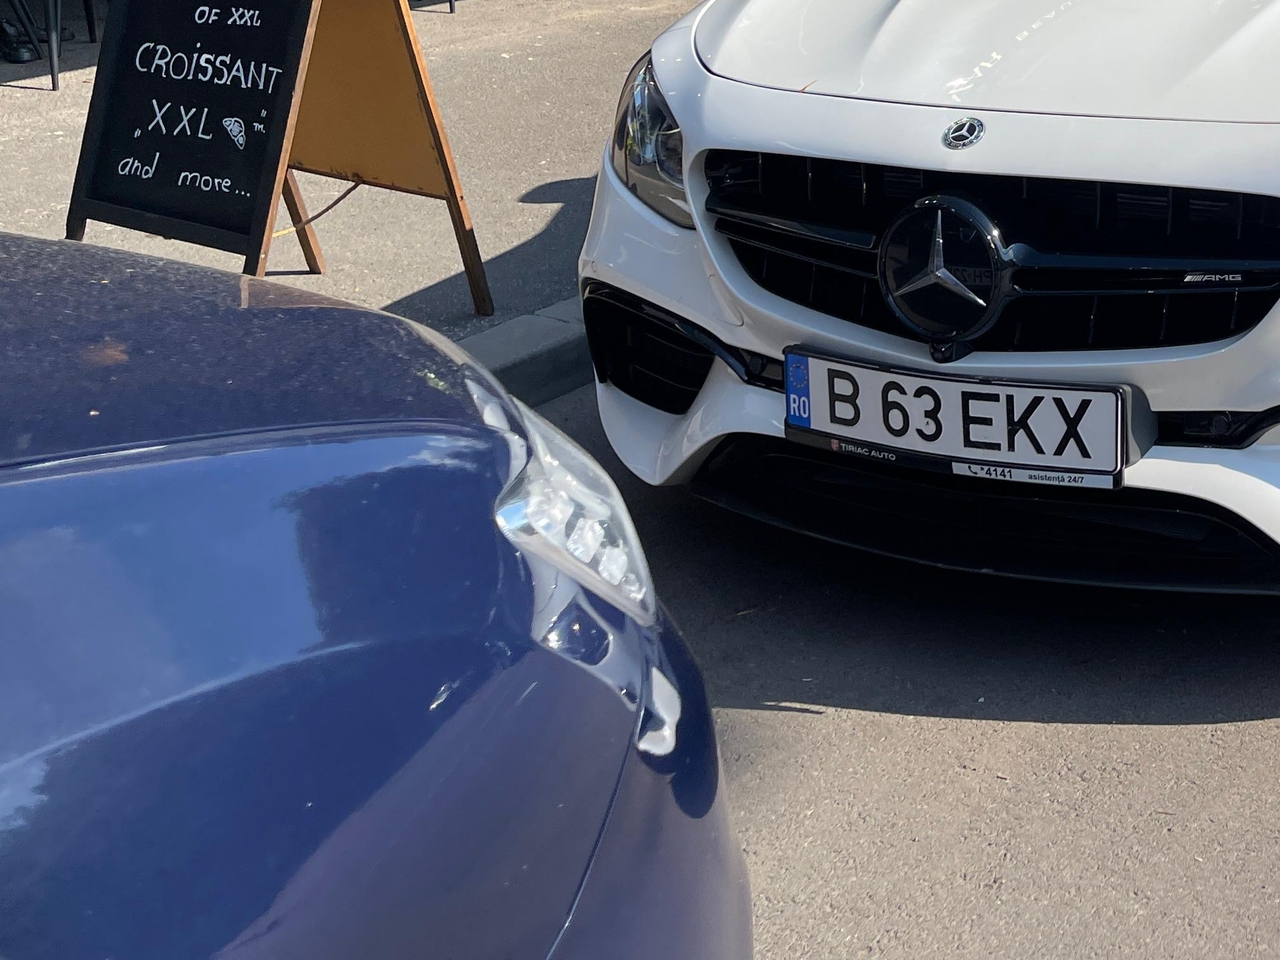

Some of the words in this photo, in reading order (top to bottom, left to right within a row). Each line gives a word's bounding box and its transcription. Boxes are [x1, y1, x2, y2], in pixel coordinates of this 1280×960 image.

[194, 5, 221, 25] OF
[226, 6, 262, 28] XXL
[117, 151, 161, 180] and
[789, 393, 811, 419] RO
[826, 367, 862, 428] B
[880, 380, 944, 443] 63
[960, 390, 1094, 460] EKX
[839, 442, 871, 457] TIRIAC
[870, 450, 897, 461] AUTO
[1067, 473, 1086, 485] 24/7
